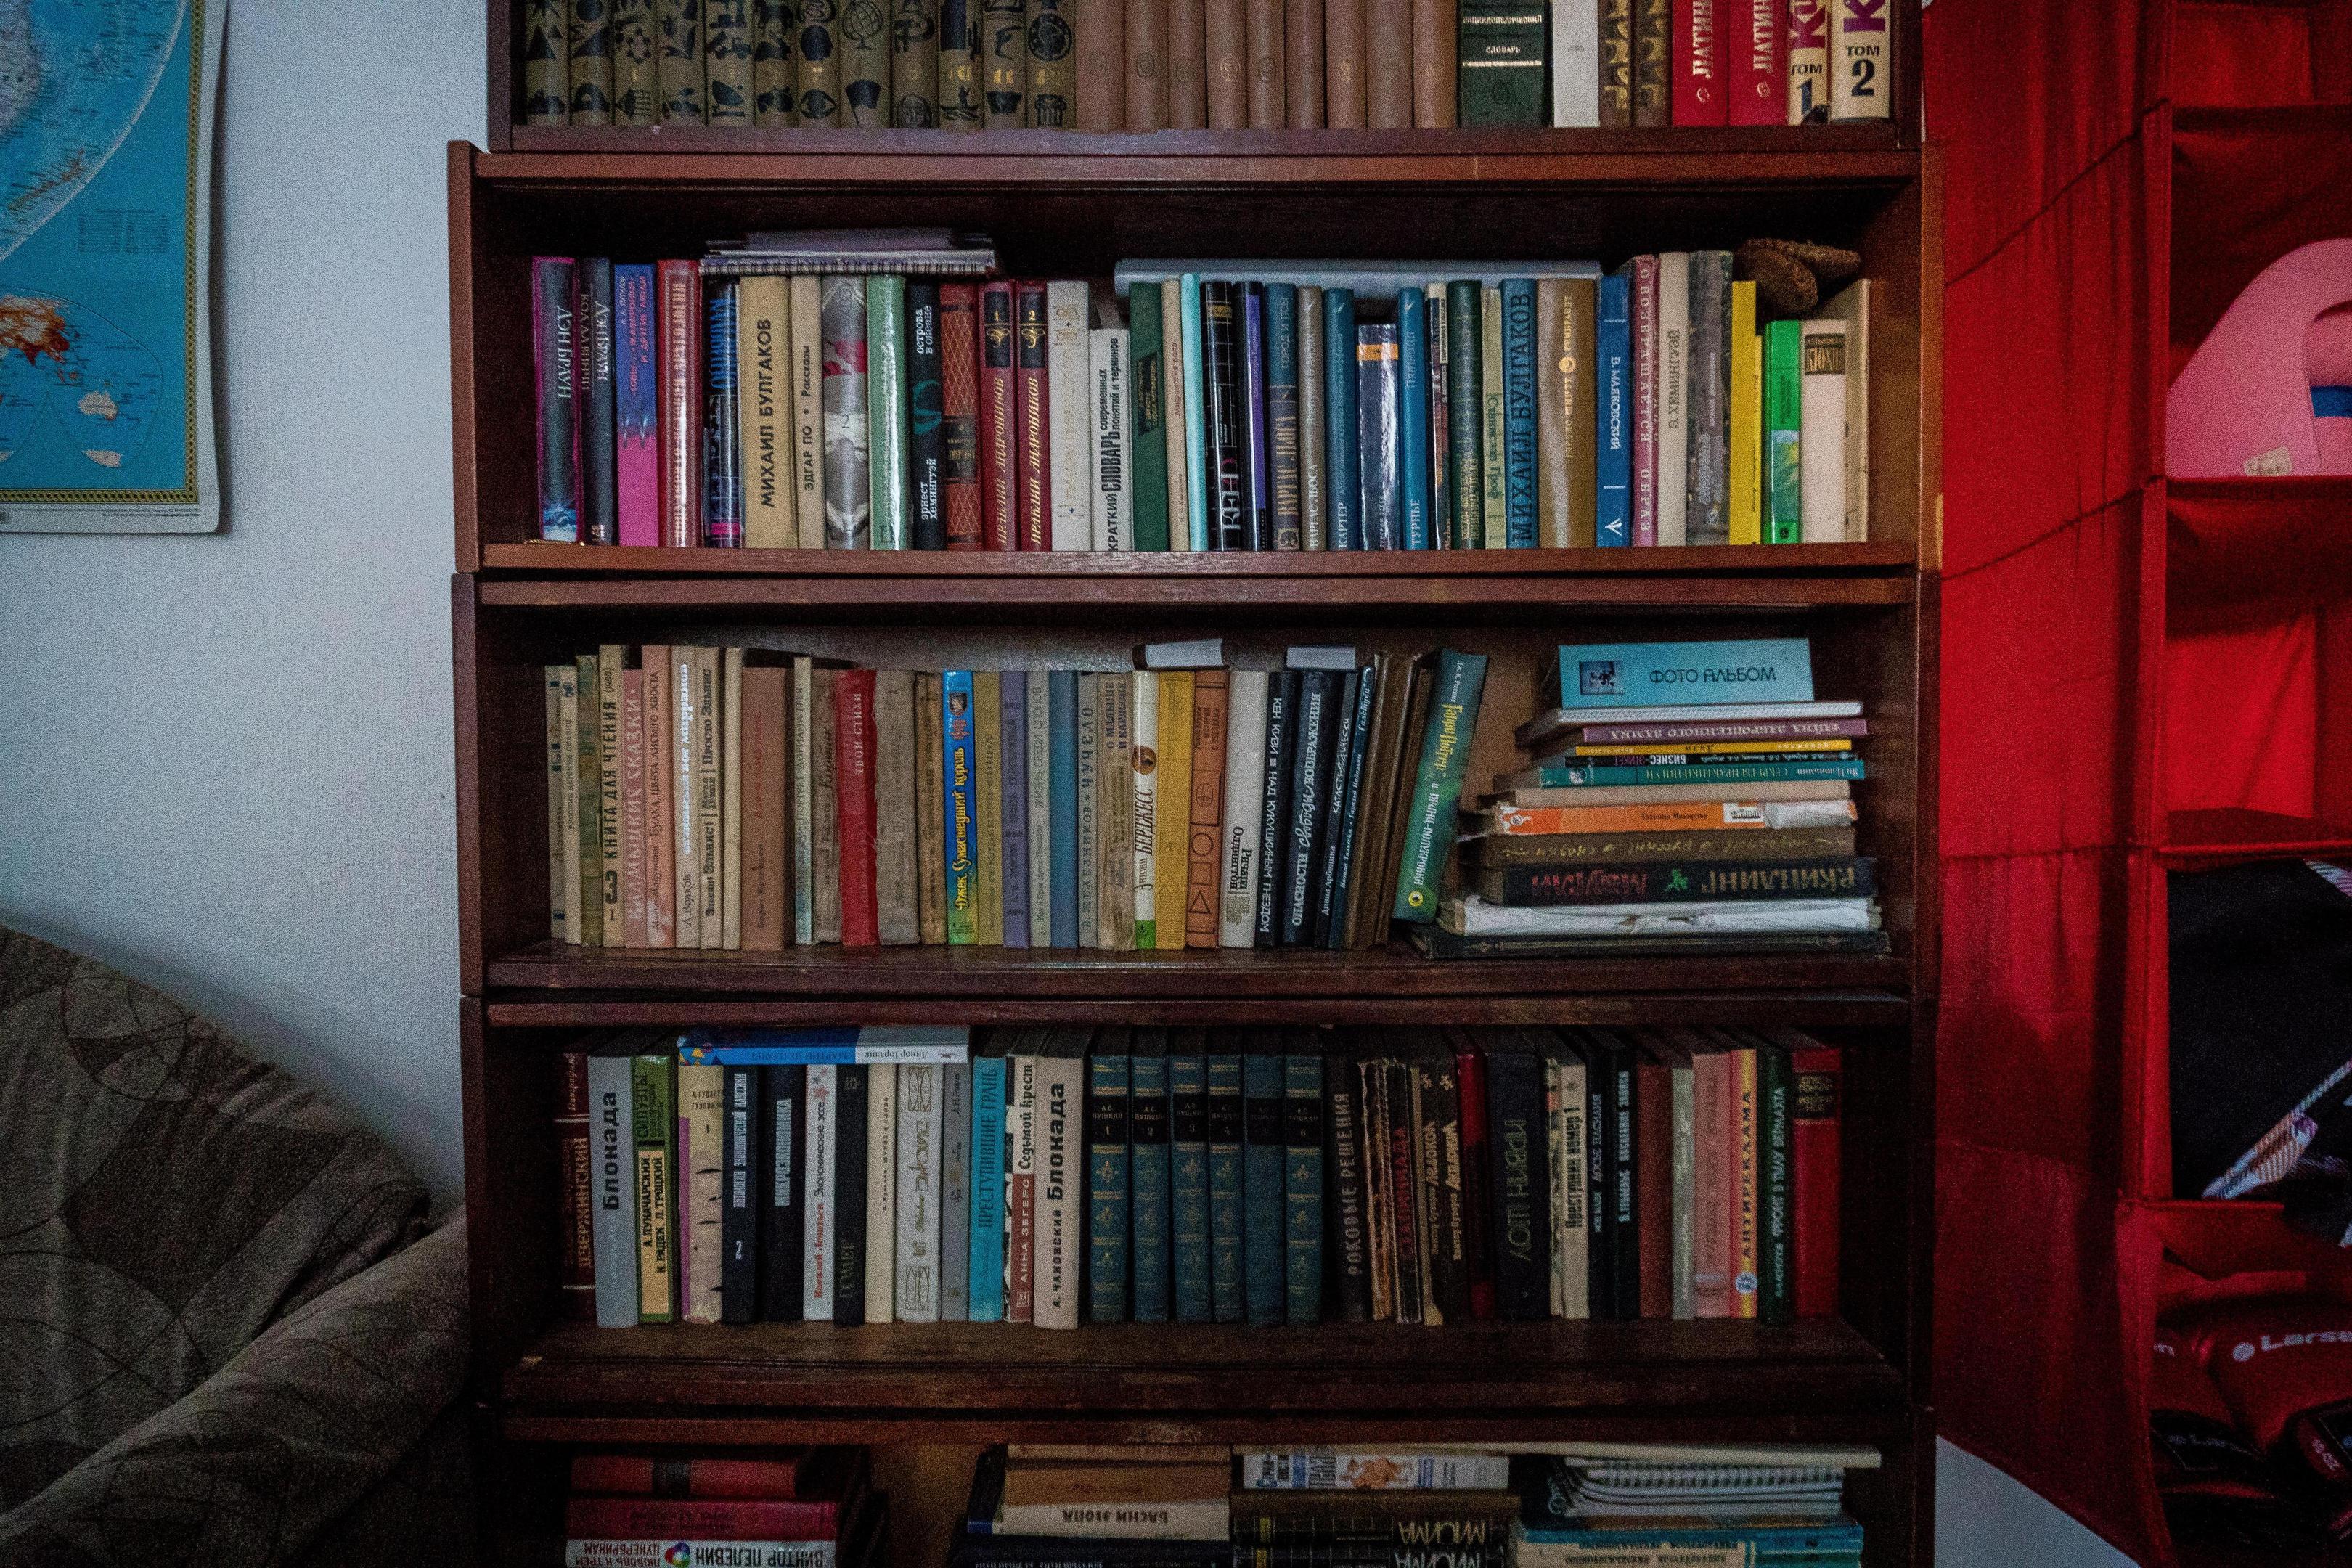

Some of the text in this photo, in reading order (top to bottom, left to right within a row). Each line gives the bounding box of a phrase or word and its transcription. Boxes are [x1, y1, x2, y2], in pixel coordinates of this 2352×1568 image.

[1485, 46, 1522, 54] СЛОВАРЬ
[1791, 64, 1823, 75] ТОМ
[1845, 45, 1880, 57] ТОМ
[1851, 59, 1875, 97] 2
[1797, 78, 1813, 115] 1
[595, 301, 611, 381] ДЭН БРАУН
[915, 309, 926, 354] острова
[1280, 296, 1289, 320] ПСЫ
[557, 304, 573, 399] ДЭН БРАУН
[1110, 338, 1120, 382] терминов
[1281, 334, 1291, 369] ГОРОД
[1668, 330, 1680, 429] Э. ХЕМИНГУЭЙ
[757, 319, 775, 508] МИХАИЛ БУЛГАКОВ
[801, 346, 814, 491] ЭДГАР ПО Рассказы
[1099, 369, 1108, 430] современных
[1109, 392, 1122, 430] понятий
[1509, 293, 1533, 541] МИХАИЛ БУЛГАКОВ
[1610, 356, 1622, 449] В. МАЯКОВСКИЙ
[1638, 285, 1650, 531] ВОЗВРАЩАЕТСЯ ОБРАЗ
[992, 377, 1008, 544] ИРАКЛИЙ АНДРОНИКОВ
[1028, 376, 1042, 545] ИРАКЛИЙ АНДРОНИКОВ
[1275, 415, 1297, 516] ВАРГАС ЛЬОСА
[1405, 331, 1421, 545] ТУРНЬЕ Пятница
[1487, 396, 1502, 499] Станислав Гроф
[927, 458, 938, 520] хемингуэй
[1101, 430, 1122, 552] КРАТКИЙ СЛОВАРЬ
[1308, 464, 1320, 547] ВАРГАС ЛЬОСА
[1338, 502, 1348, 548] КАРТЕР
[1106, 682, 1115, 738] МАЛЫШЕ
[1117, 682, 1127, 738] КАРЛСОНЕ
[1649, 666, 1776, 685] ФОТО АЛЬБОМ
[650, 671, 661, 796] ЦВЕТА ЛИСЬЕГО ХВОСТА
[701, 668, 715, 764] Просто Эльвис
[852, 692, 862, 735] СТИХИ
[1033, 687, 1045, 808] ЖИЗНЬ СРЕДИ СЛОНОВ
[1081, 707, 1093, 788] ЧУЧЕЛО
[1442, 703, 1463, 735] Гарри
[1609, 723, 1841, 740] ТАЙНА ЗАБРОШЕННОГО ЗАМКА
[602, 701, 618, 859] КНИГА ДЛЯ ЧТЕНИЯ
[1614, 754, 1686, 767] БИЗНЕС-ЭТИКЕТ
[626, 698, 643, 921] КАЛМЫЦКИЕ СКАЗКИ
[952, 747, 971, 910] Джек Сумасшедший король
[1134, 785, 1155, 855] БЕРДЖЕСС
[1259, 697, 1281, 932] КЕН КИЗИ НАД КУКУШКИНЫМ ГНЕЗДОМ
[1291, 693, 1321, 926] ОПАСНОСТИ ВООБРАЖЕНИЯ
[703, 822, 715, 874] Эльвис!
[1082, 805, 1092, 913] ЖЕЛЕЗНИКОВ
[1230, 826, 1244, 890] Олдингтон
[1239, 849, 1251, 890] Ричард
[1320, 846, 1336, 915] Диана Арбенина
[1701, 866, 1856, 894] Р.КИПЛИНГ
[682, 873, 693, 915] Волков
[864, 1050, 928, 1060] Линор Горалик
[635, 1072, 648, 1138] СИЛУЭТЫ
[1017, 1065, 1035, 1170] Седьмой крест
[1567, 1116, 1583, 1155] номер
[1592, 1093, 1602, 1146] НАСИЛИЯ
[1773, 1087, 1786, 1147] ВЕРМАХТА
[602, 1092, 619, 1211] Блокада
[775, 1098, 792, 1207] МИКРОЭКОНОМИКА
[814, 1101, 825, 1198] Экономические эссе
[977, 1069, 998, 1229] ПРЕСТУПИВШИЕ ГРАНЬ
[1046, 1083, 1065, 1201] Блокада
[1592, 1147, 1603, 1183] ДОСЬЕ
[1741, 1091, 1751, 1259] АНТИРЕКЛАМА
[1772, 1150, 1785, 1181] ТЫЛУ
[572, 1137, 591, 1267] ДЗЕРЖИНСКИЙ
[653, 1157, 666, 1273] К. Л. ТРОЦКИЙ
[1334, 1093, 1363, 1275] РОКОВЫЕ РЕШЕНИЯ
[1393, 1126, 1413, 1259] СТАЛИНИАДА
[1503, 1119, 1532, 1262] ИРВИН ШОУ
[1565, 1158, 1584, 1228] Преступник
[1771, 1195, 1785, 1237] ФРОНТ
[644, 1237, 652, 1247] А.
[812, 1203, 825, 1299] Василий Леонтьев
[1021, 1179, 1030, 1283] АННА ЗЕГЕРС
[1051, 1209, 1062, 1307] А. ЧАКОВСКИЙ
[839, 1239, 854, 1299] ГОМЕР
[584, 1543, 660, 1556] ЦУКЕРБРИНАМ
[1062, 1509, 1168, 1524] БАСНИ ЭЗОПА
[1398, 1521, 1485, 1544] МИСИМА
[576, 1558, 602, 1567] ТРЕМ
[695, 1548, 823, 1568] ВИКТОР ПЕЛЕВИН
